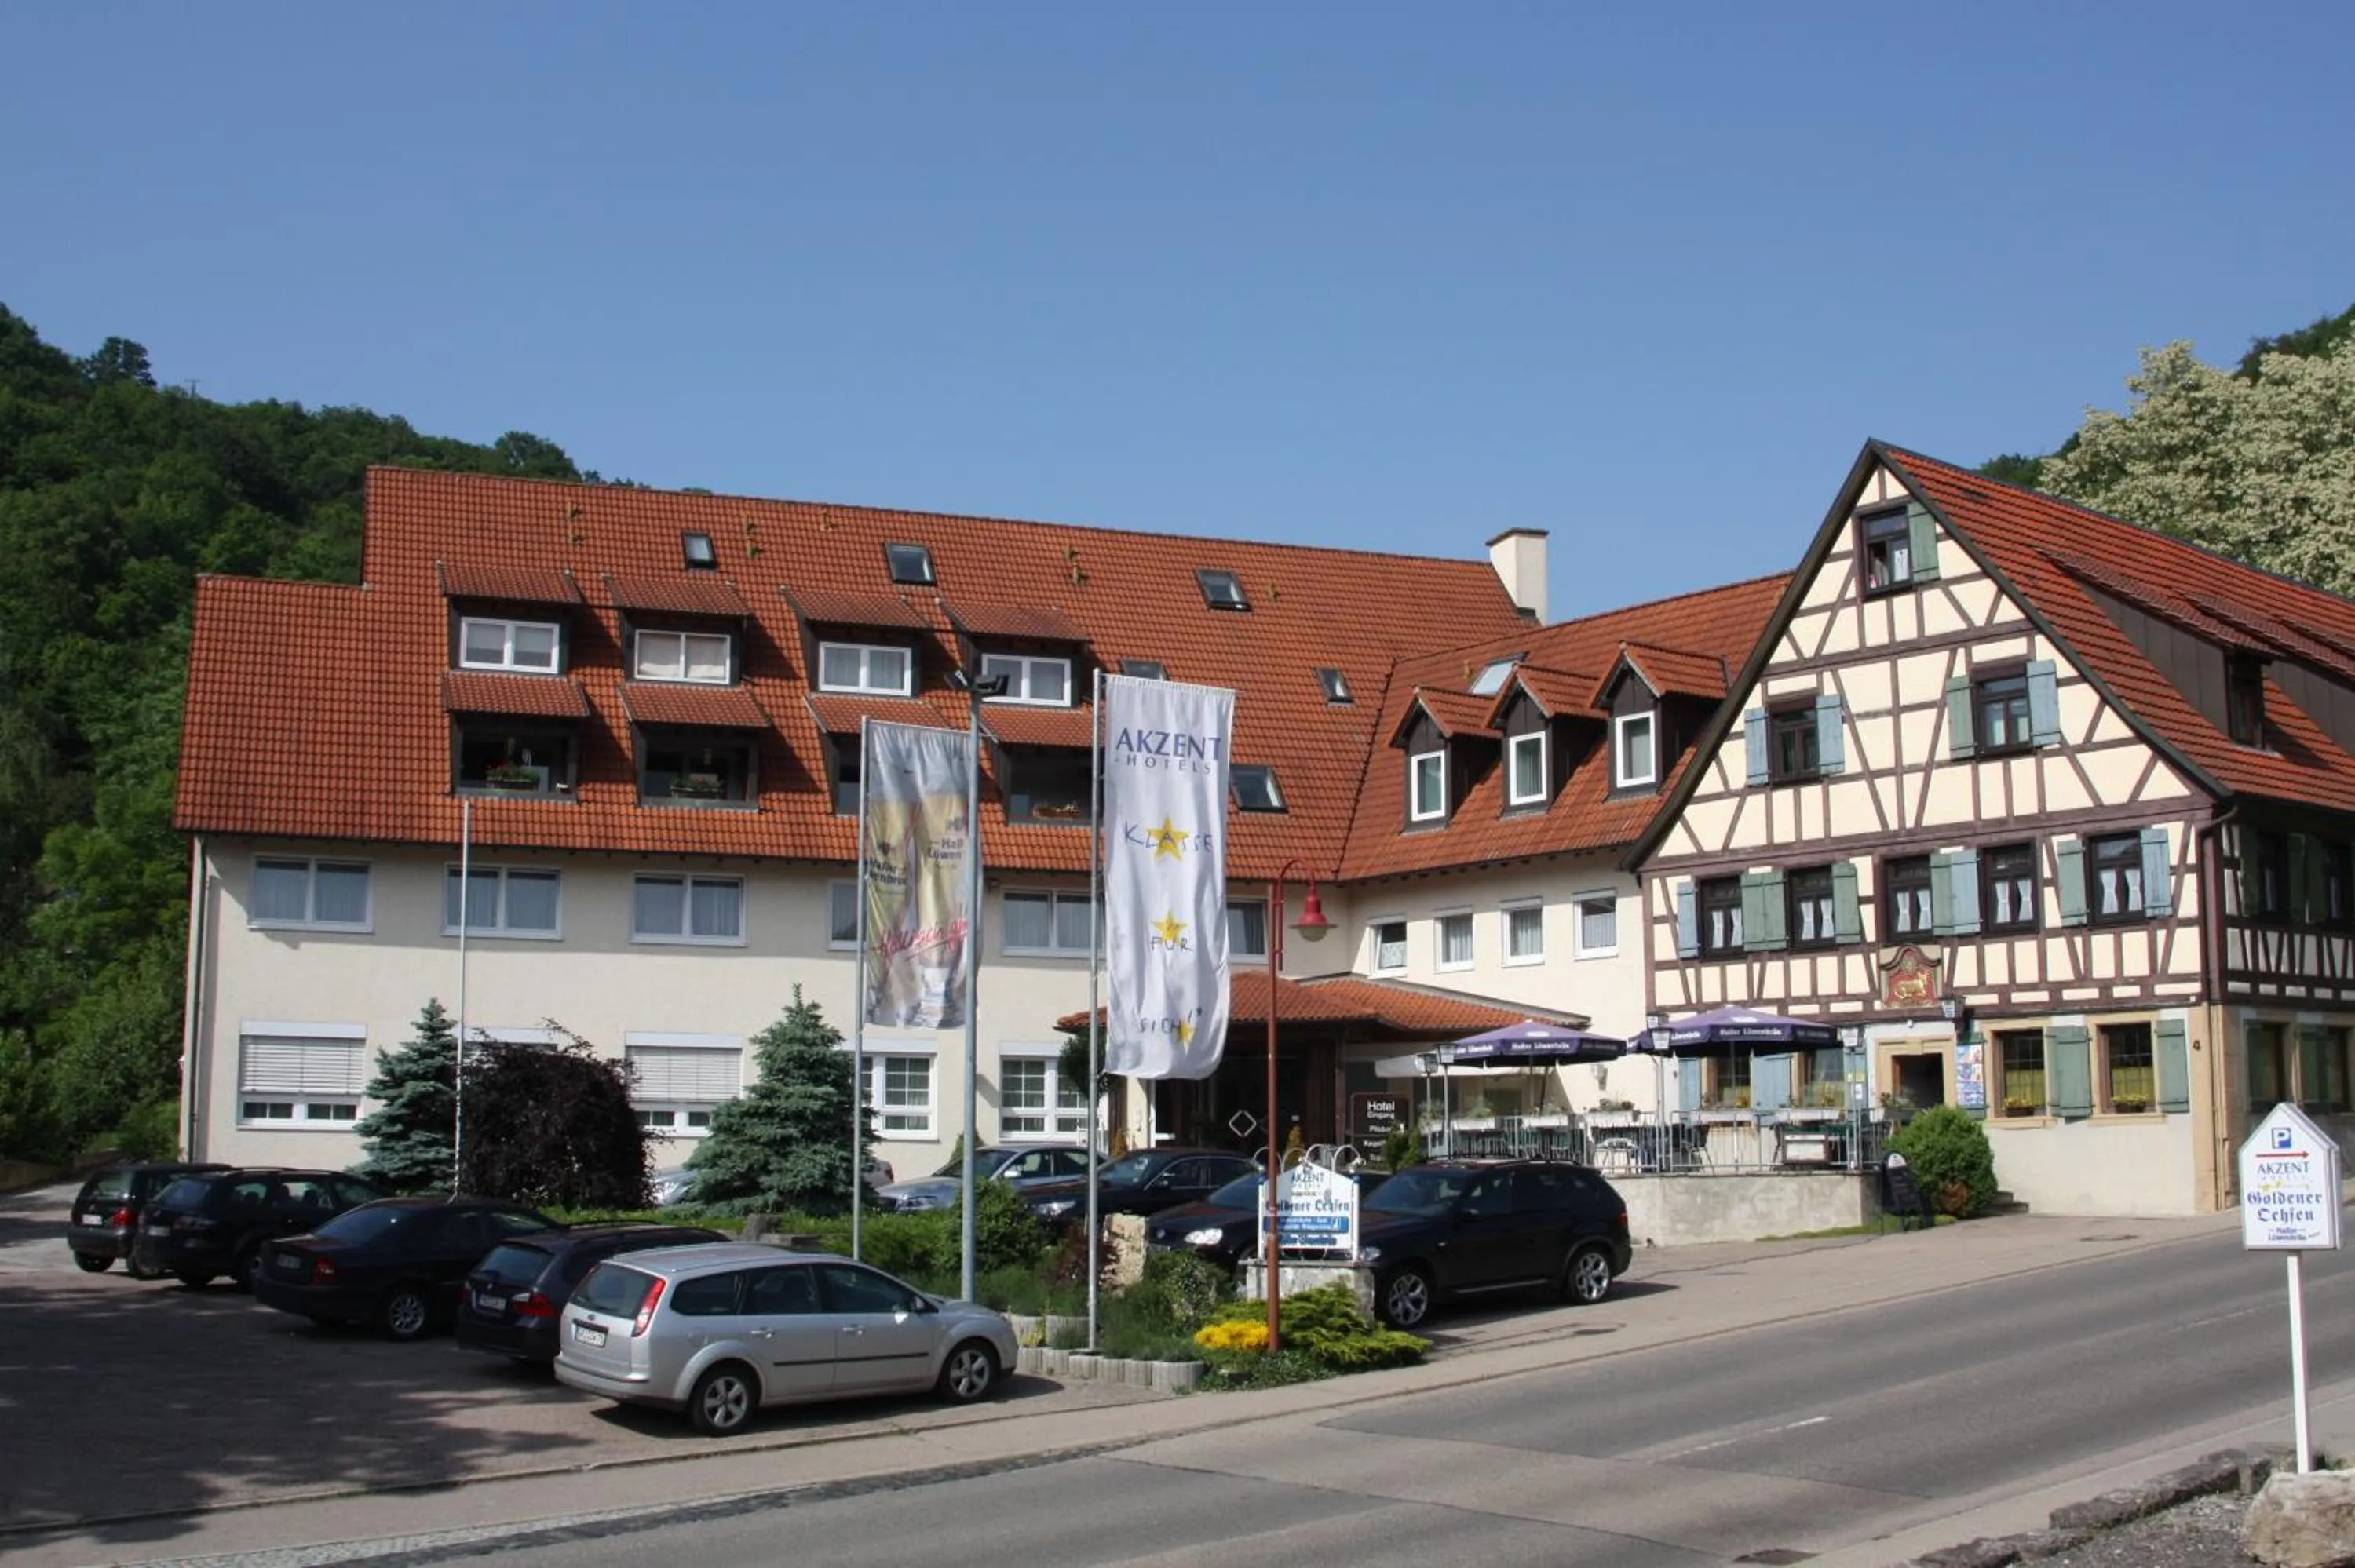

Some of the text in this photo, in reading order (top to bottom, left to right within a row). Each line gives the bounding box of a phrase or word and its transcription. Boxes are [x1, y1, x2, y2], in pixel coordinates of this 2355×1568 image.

[1115, 727, 1221, 761] AKZENT
[1126, 753, 1212, 775] HOTELS
[1124, 822, 1213, 852] KLASSE
[1367, 1100, 1395, 1111] Hotel
[2257, 1161, 2310, 1174] AKZENT
[1291, 1172, 1324, 1183] AKZENT
[1265, 1198, 1312, 1212] ldener
[2247, 1191, 2323, 1205] Goldener
